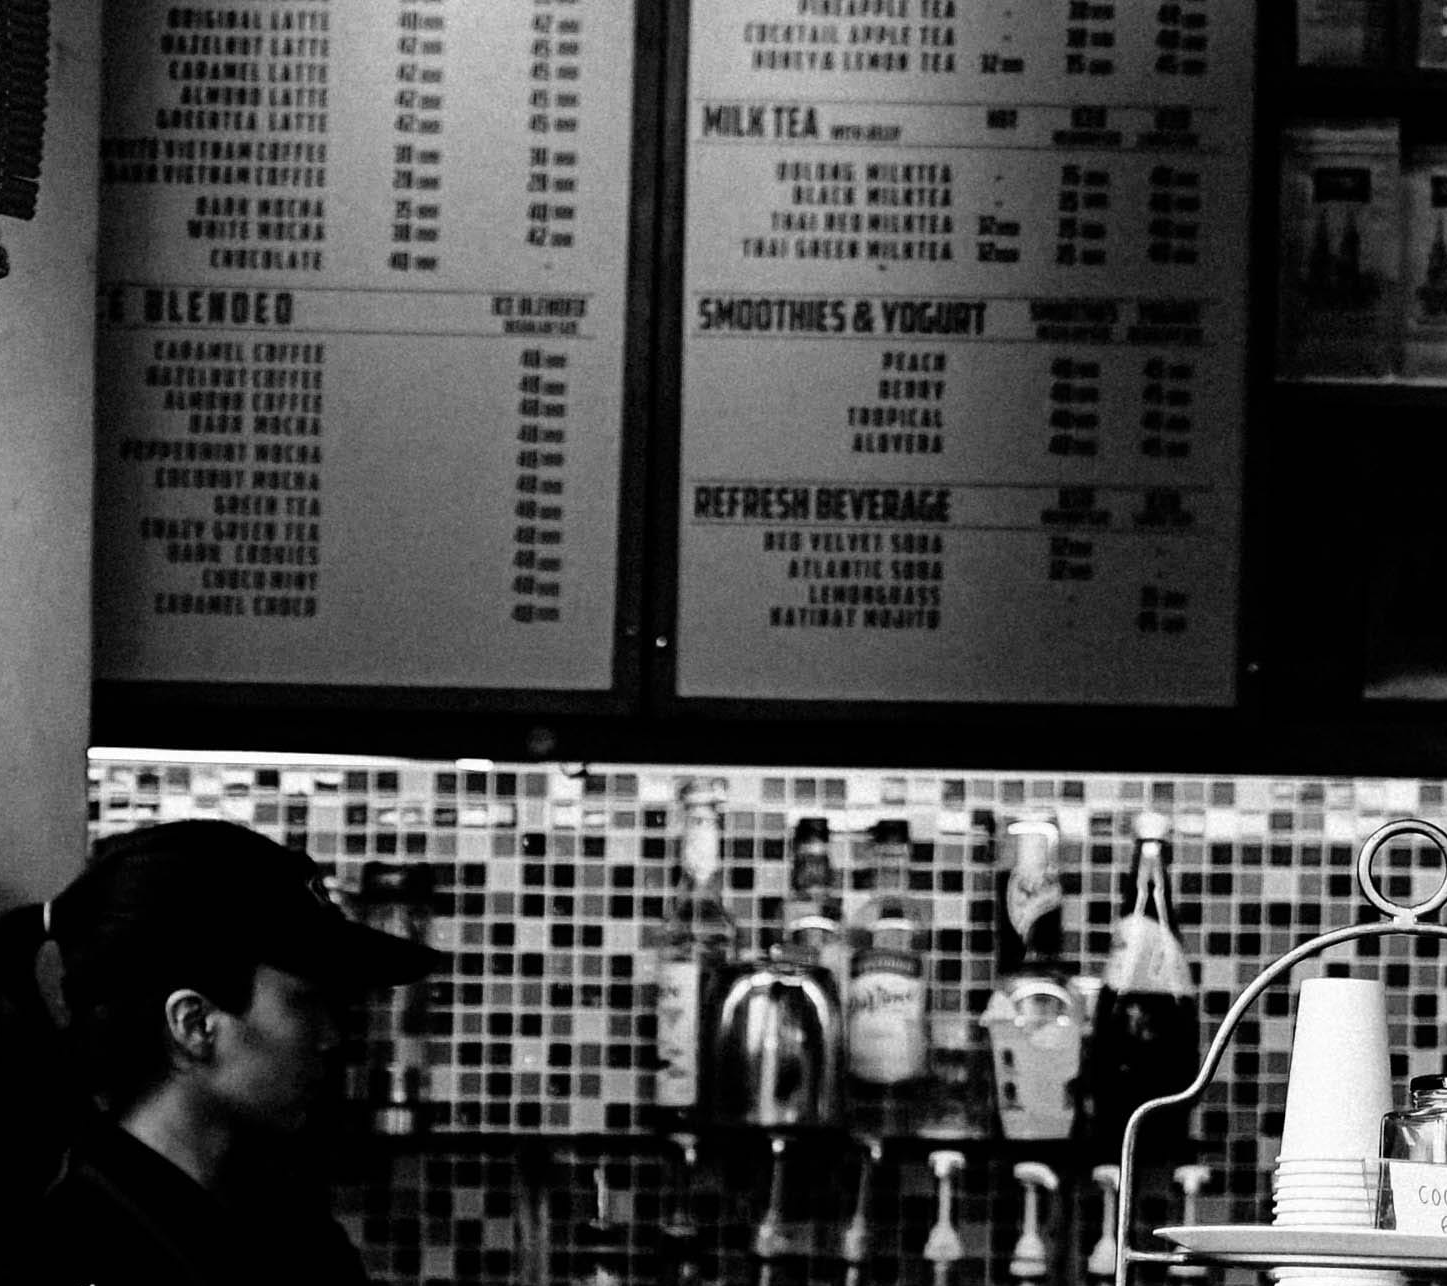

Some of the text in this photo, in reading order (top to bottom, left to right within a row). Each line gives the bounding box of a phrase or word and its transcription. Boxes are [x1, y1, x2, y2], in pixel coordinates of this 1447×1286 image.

[702, 105, 766, 137] MILK
[774, 105, 819, 139] TEA
[144, 288, 294, 325] BLENDED
[696, 296, 987, 335] SMOOTHIES & YOGURT
[693, 485, 952, 523] REFRESH BEVERAGE
